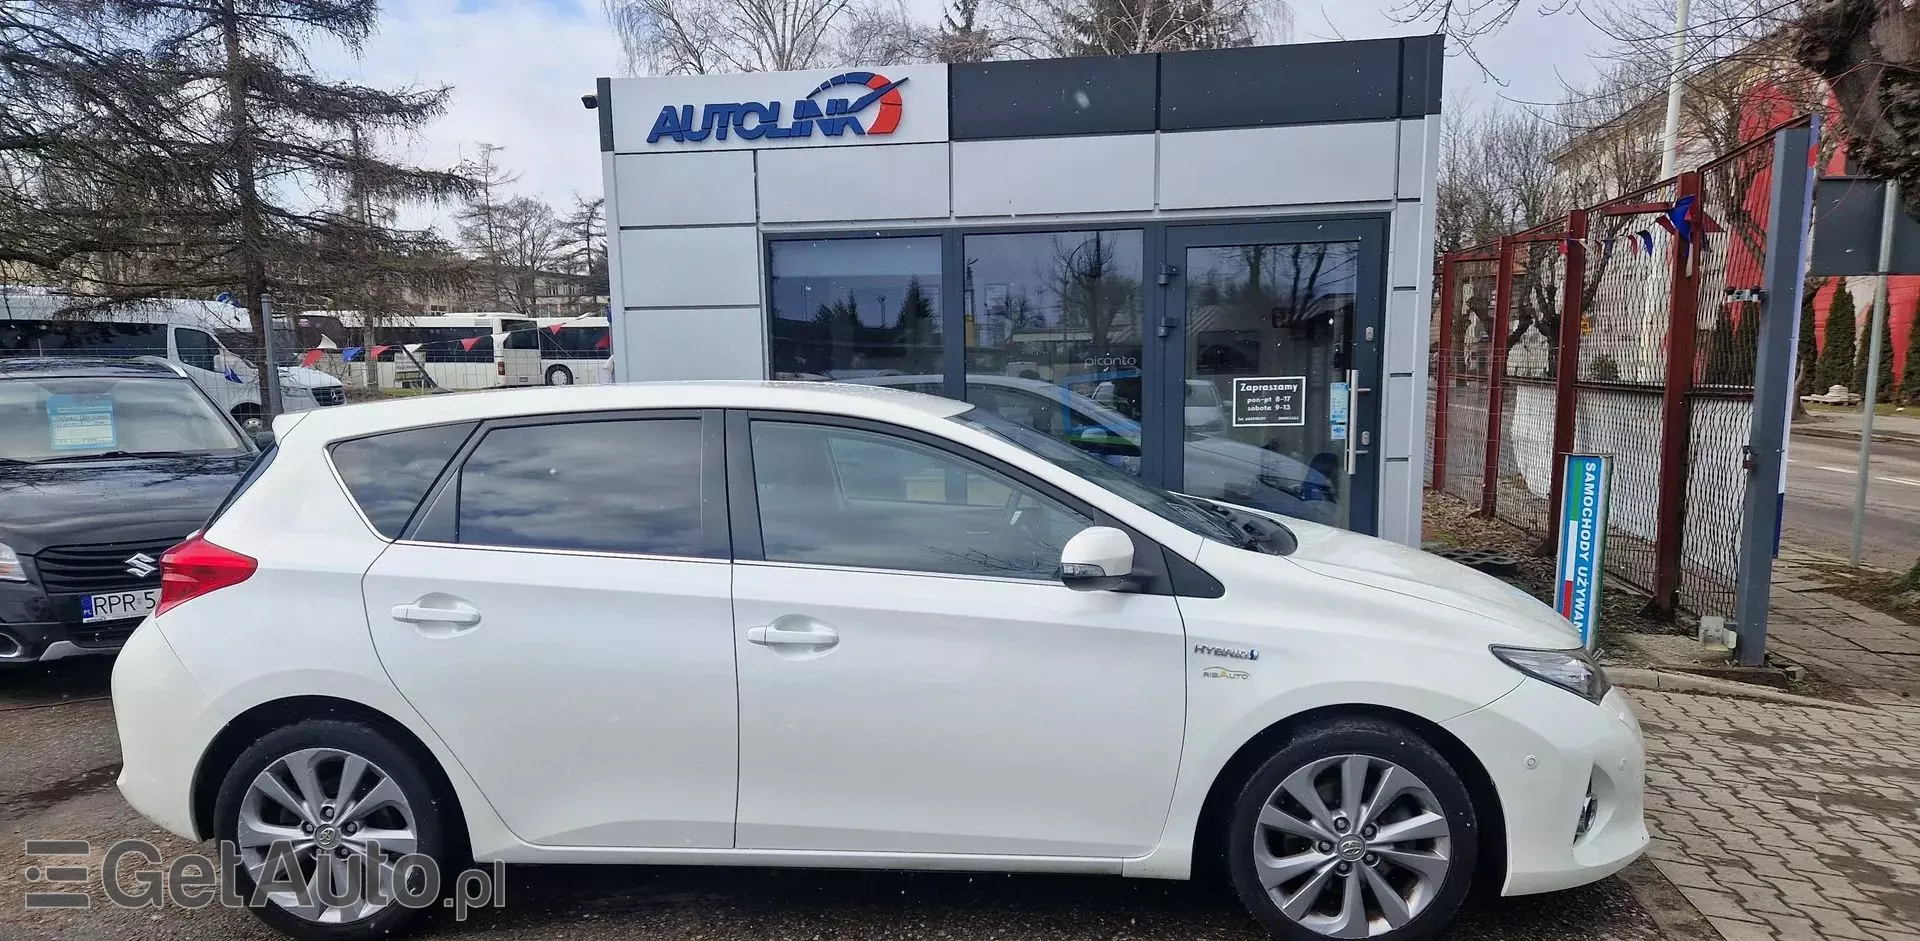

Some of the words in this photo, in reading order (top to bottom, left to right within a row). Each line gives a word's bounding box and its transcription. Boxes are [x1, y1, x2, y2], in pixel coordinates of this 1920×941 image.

[646, 98, 866, 144] AUTOLINK
[1084, 356, 1137, 369] picanto
[1240, 383, 1298, 393] Zapraszamy
[1247, 396, 1272, 404] pon-pt
[1579, 462, 1597, 562] SAMOCHODY
[93, 593, 137, 616] RPR
[144, 591, 156, 610] 5
[1572, 566, 1588, 634] UŻYWAN
[1194, 644, 1248, 660] HYBRID
